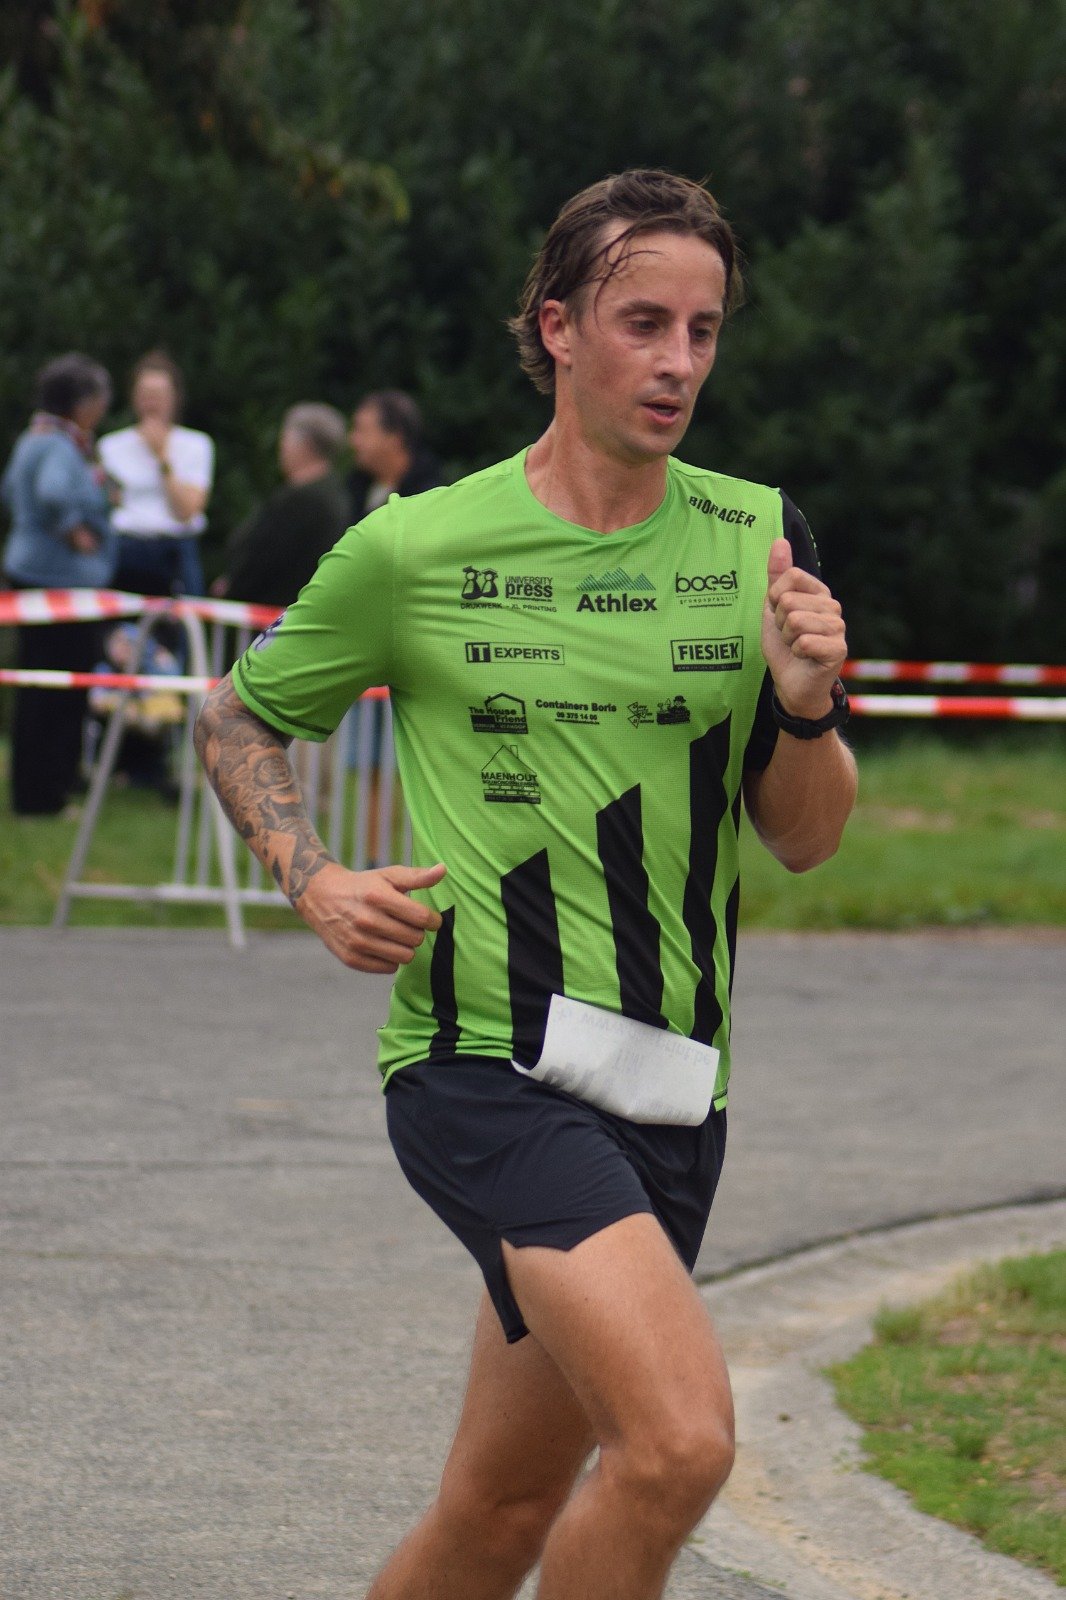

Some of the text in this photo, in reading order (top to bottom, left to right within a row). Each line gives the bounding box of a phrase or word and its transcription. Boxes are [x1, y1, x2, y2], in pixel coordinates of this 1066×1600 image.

[688, 495, 757, 528] BIORACER
[505, 576, 553, 586] UNIVERSITY
[505, 583, 553, 599] press
[523, 604, 557, 612] PRINTING
[576, 593, 658, 613] Athlex
[494, 647, 560, 660] EXPERTS
[677, 642, 739, 660] FIESIEK
[468, 706, 517, 715] The House
[535, 699, 617, 712] Containers Boris
[496, 714, 526, 723] Friend
[481, 772, 538, 782] MAENHOUT
